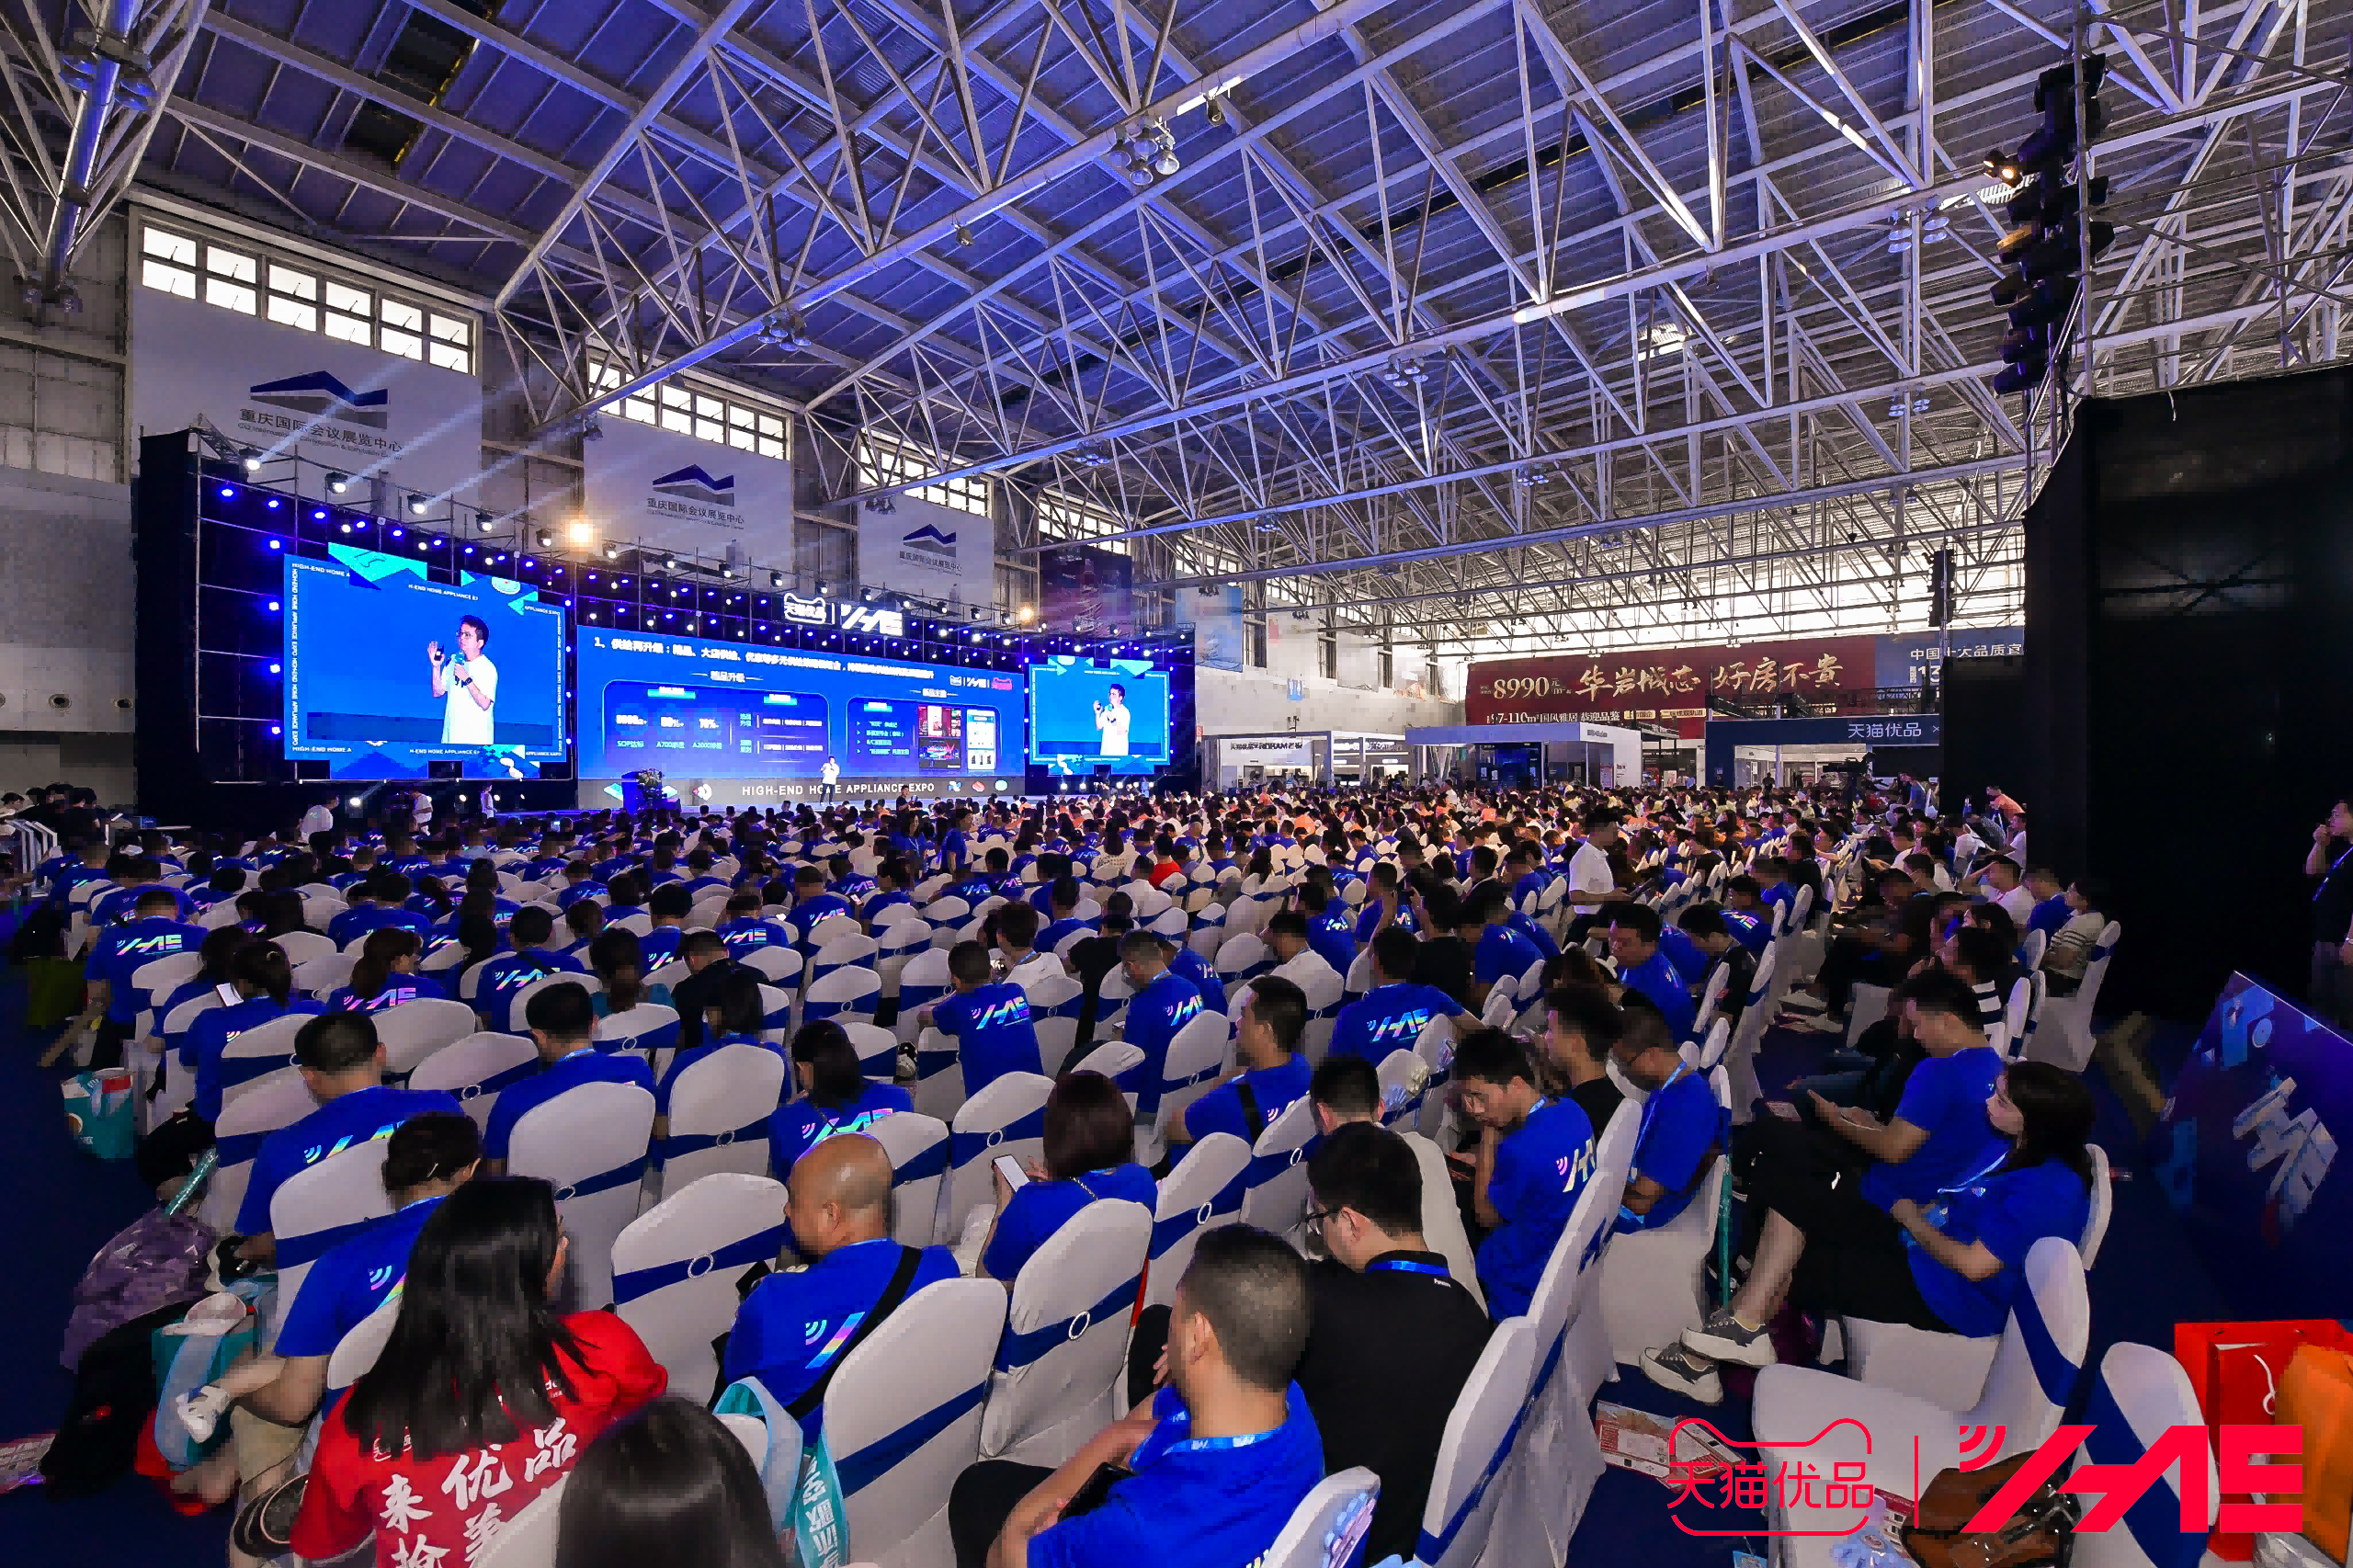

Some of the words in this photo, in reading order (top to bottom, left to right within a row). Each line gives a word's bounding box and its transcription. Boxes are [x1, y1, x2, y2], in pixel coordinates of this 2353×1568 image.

[239, 408, 403, 452] 重庆国际会议展览中心
[647, 497, 745, 525] 重庆国际会议展览中心
[1494, 676, 1549, 699] 8990
[1847, 722, 1922, 739] 天猫优品
[742, 785, 803, 796] HIGH-END
[908, 783, 935, 792] EXPO
